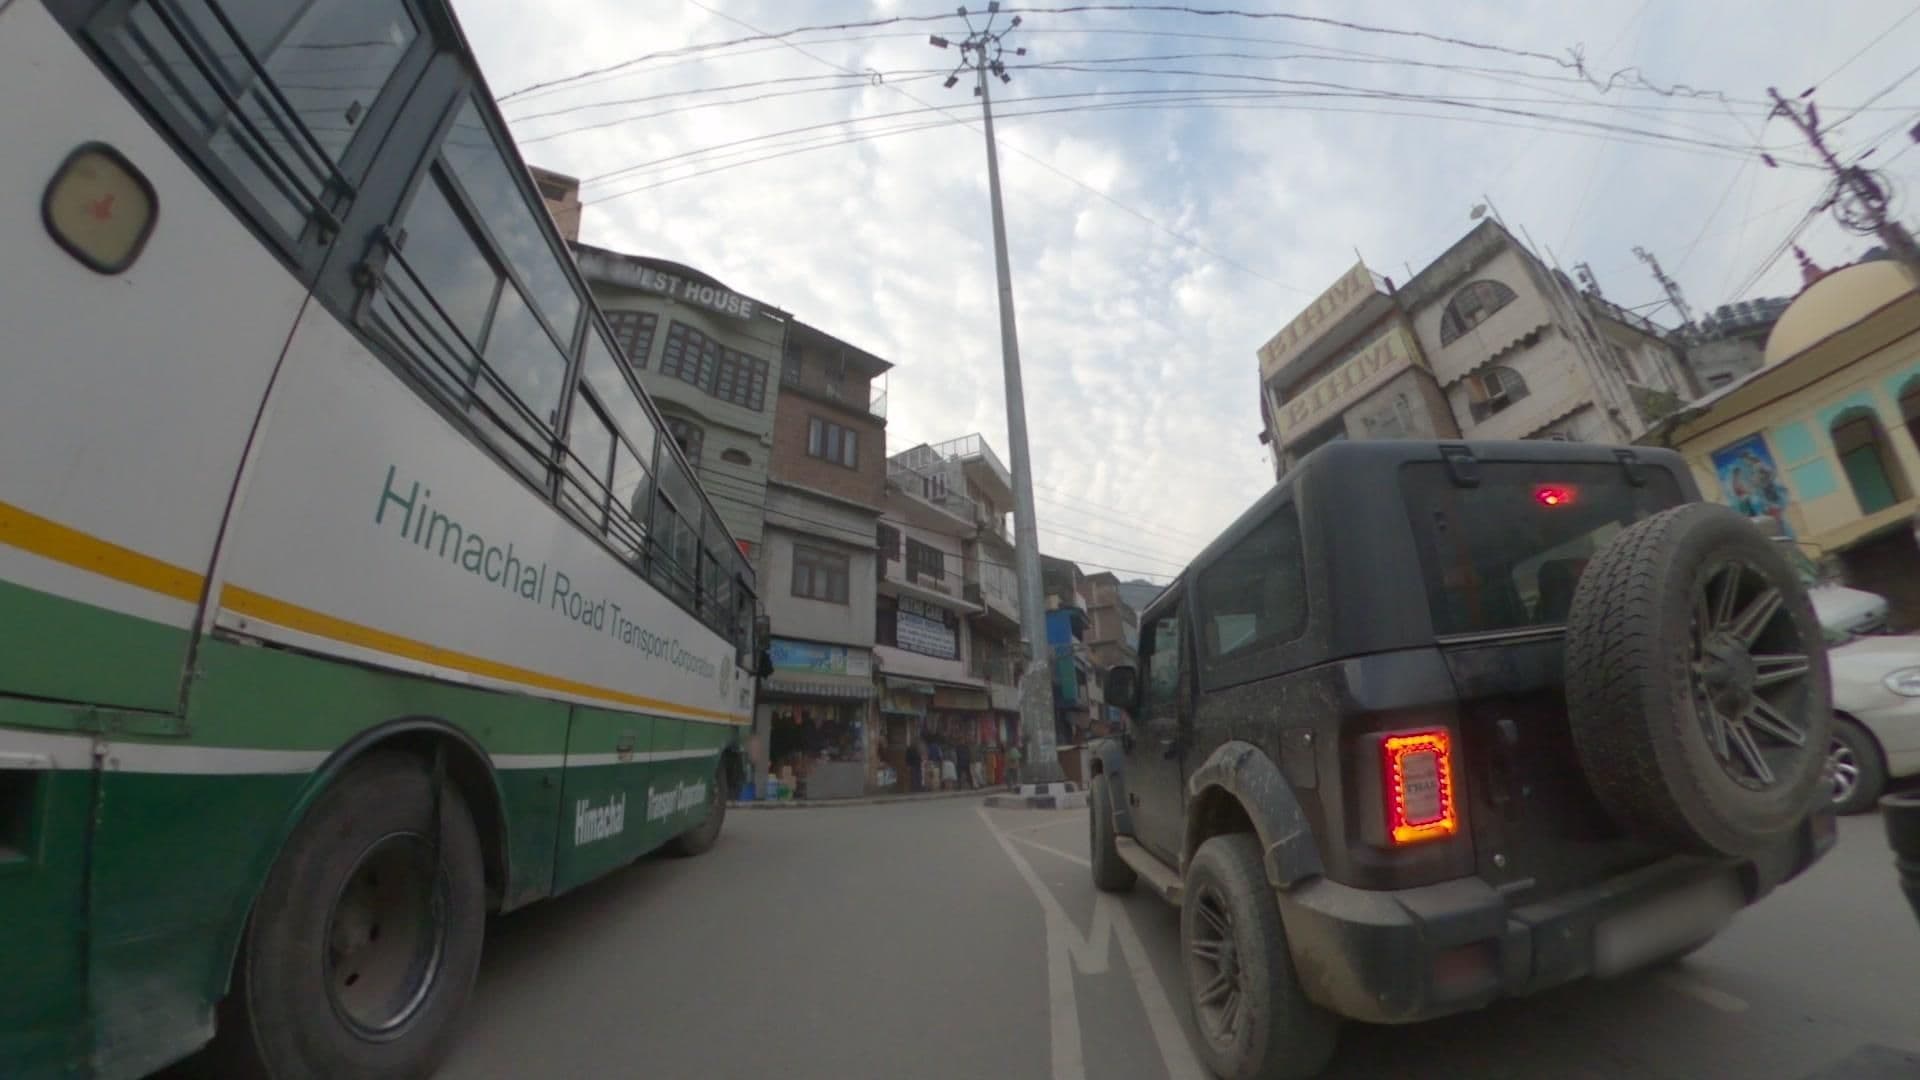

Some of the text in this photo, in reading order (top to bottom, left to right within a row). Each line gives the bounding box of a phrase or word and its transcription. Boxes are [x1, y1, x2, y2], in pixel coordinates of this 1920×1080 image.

[627, 264, 682, 294] EST
[684, 280, 753, 319] HOUSE
[373, 464, 548, 606] Himachal
[551, 570, 607, 632] Road
[609, 602, 670, 663] Transport
[574, 791, 626, 847] Himachal
